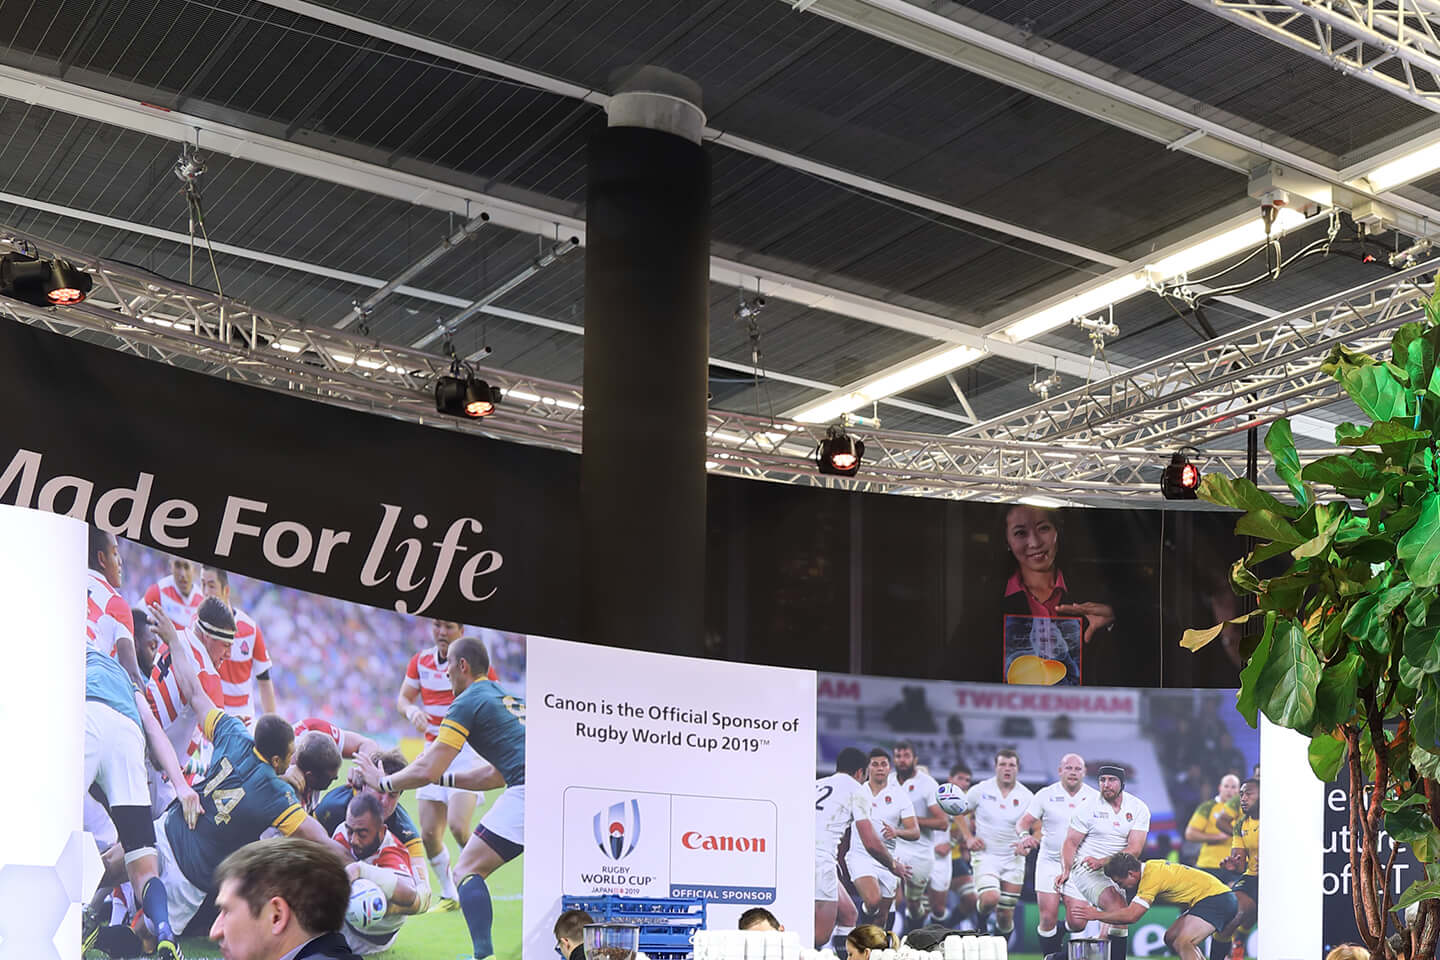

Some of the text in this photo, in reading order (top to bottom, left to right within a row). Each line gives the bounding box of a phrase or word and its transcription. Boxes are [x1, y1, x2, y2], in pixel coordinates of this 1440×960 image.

[0, 448, 503, 614] Made For life
[544, 694, 597, 714] Canon
[601, 700, 613, 715] is
[618, 702, 644, 718] the
[649, 705, 708, 725] Official
[712, 712, 778, 731] Sponsor
[782, 718, 800, 732] of
[955, 689, 1134, 714] TWICKENHAM
[576, 723, 628, 744] Rugby
[632, 727, 682, 746] World
[686, 733, 718, 752] Cup
[681, 831, 766, 852] Canon
[581, 873, 626, 885] WORLD
[602, 866, 630, 874] RUGBY
[672, 889, 772, 901] OFFICIAL SPONSOR
